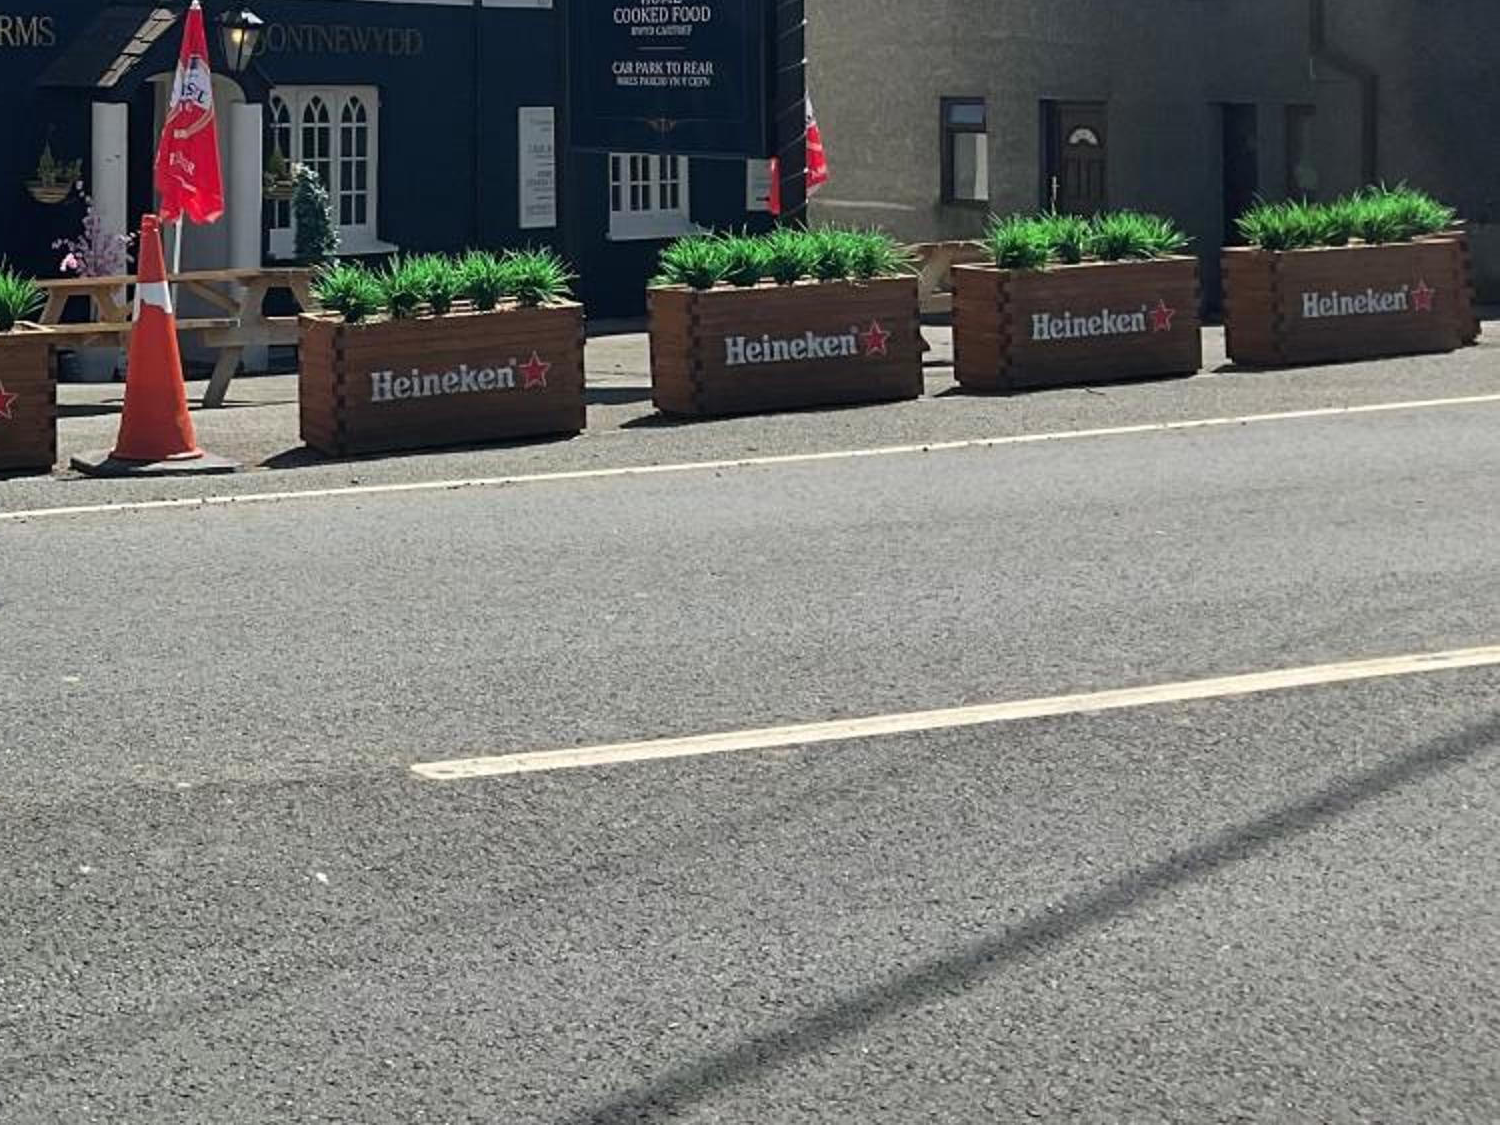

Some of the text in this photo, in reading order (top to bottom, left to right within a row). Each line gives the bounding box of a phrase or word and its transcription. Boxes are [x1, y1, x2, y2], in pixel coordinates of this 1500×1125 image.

[613, 5, 712, 24] COOKED FOOD
[612, 60, 714, 75] CAR PARK TO REAR
[1302, 288, 1408, 318] Heineken
[1031, 308, 1147, 341] Heineken
[724, 330, 858, 365] Heineken
[370, 364, 516, 402] Heineken
